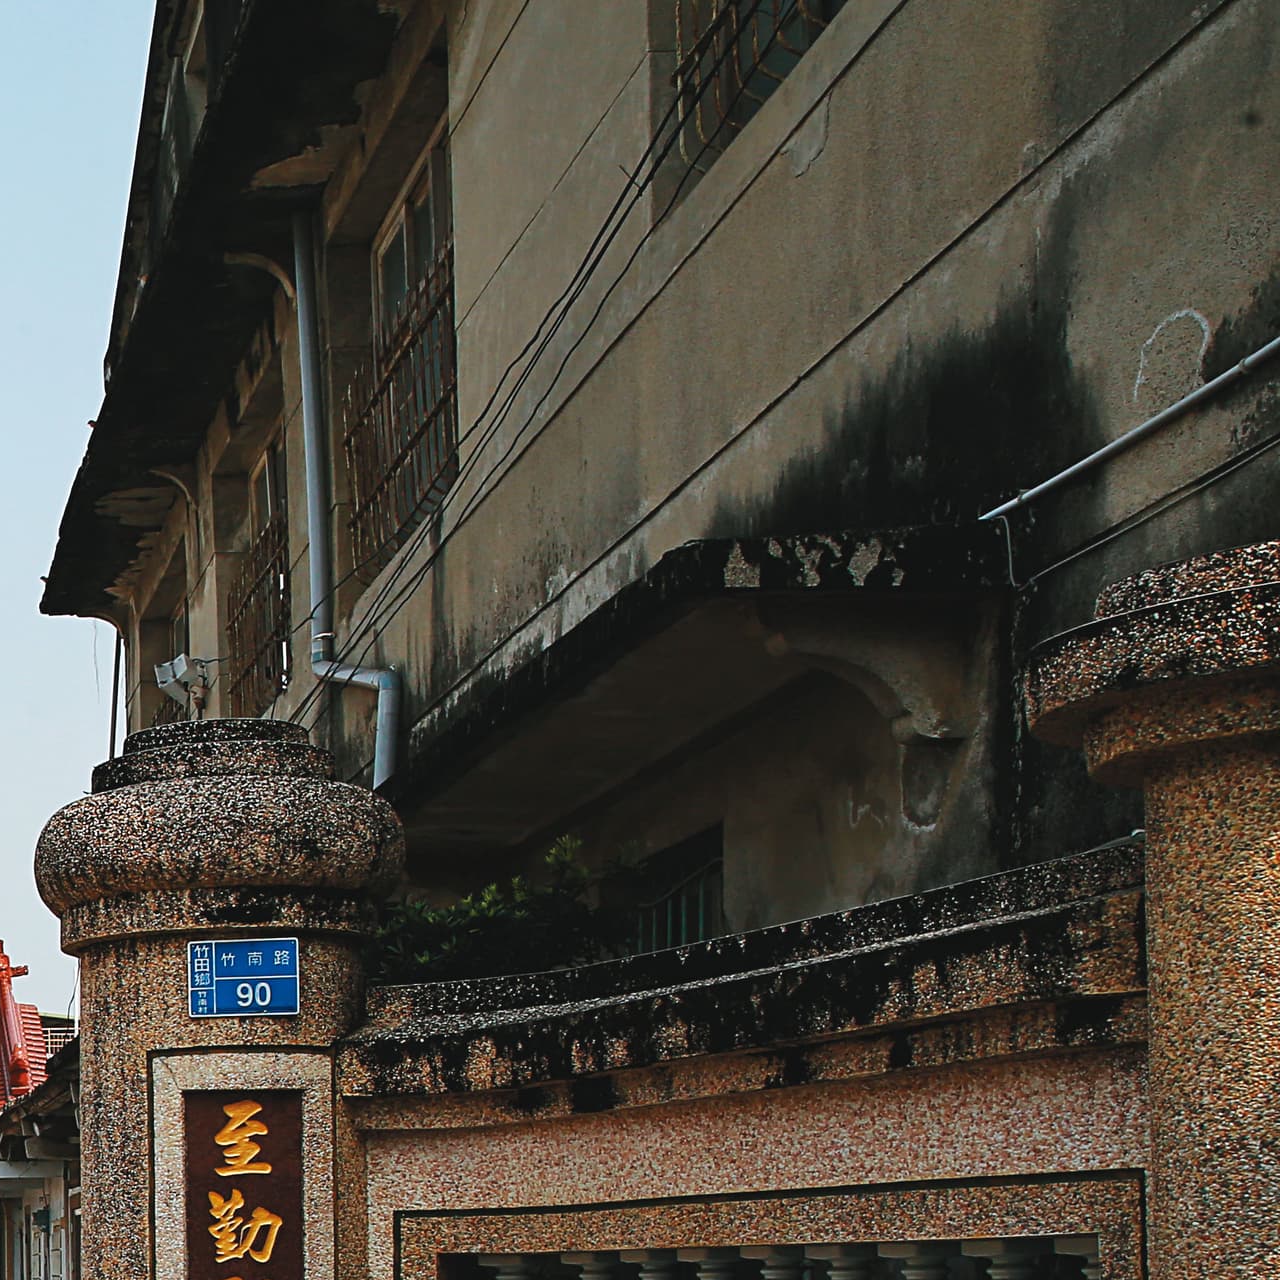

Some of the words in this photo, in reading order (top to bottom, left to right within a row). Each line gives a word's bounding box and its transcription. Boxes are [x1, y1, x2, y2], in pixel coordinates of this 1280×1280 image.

[194, 944, 210, 986] 竹田鄉
[220, 950, 291, 967] 竹南路
[236, 981, 272, 1008] 90
